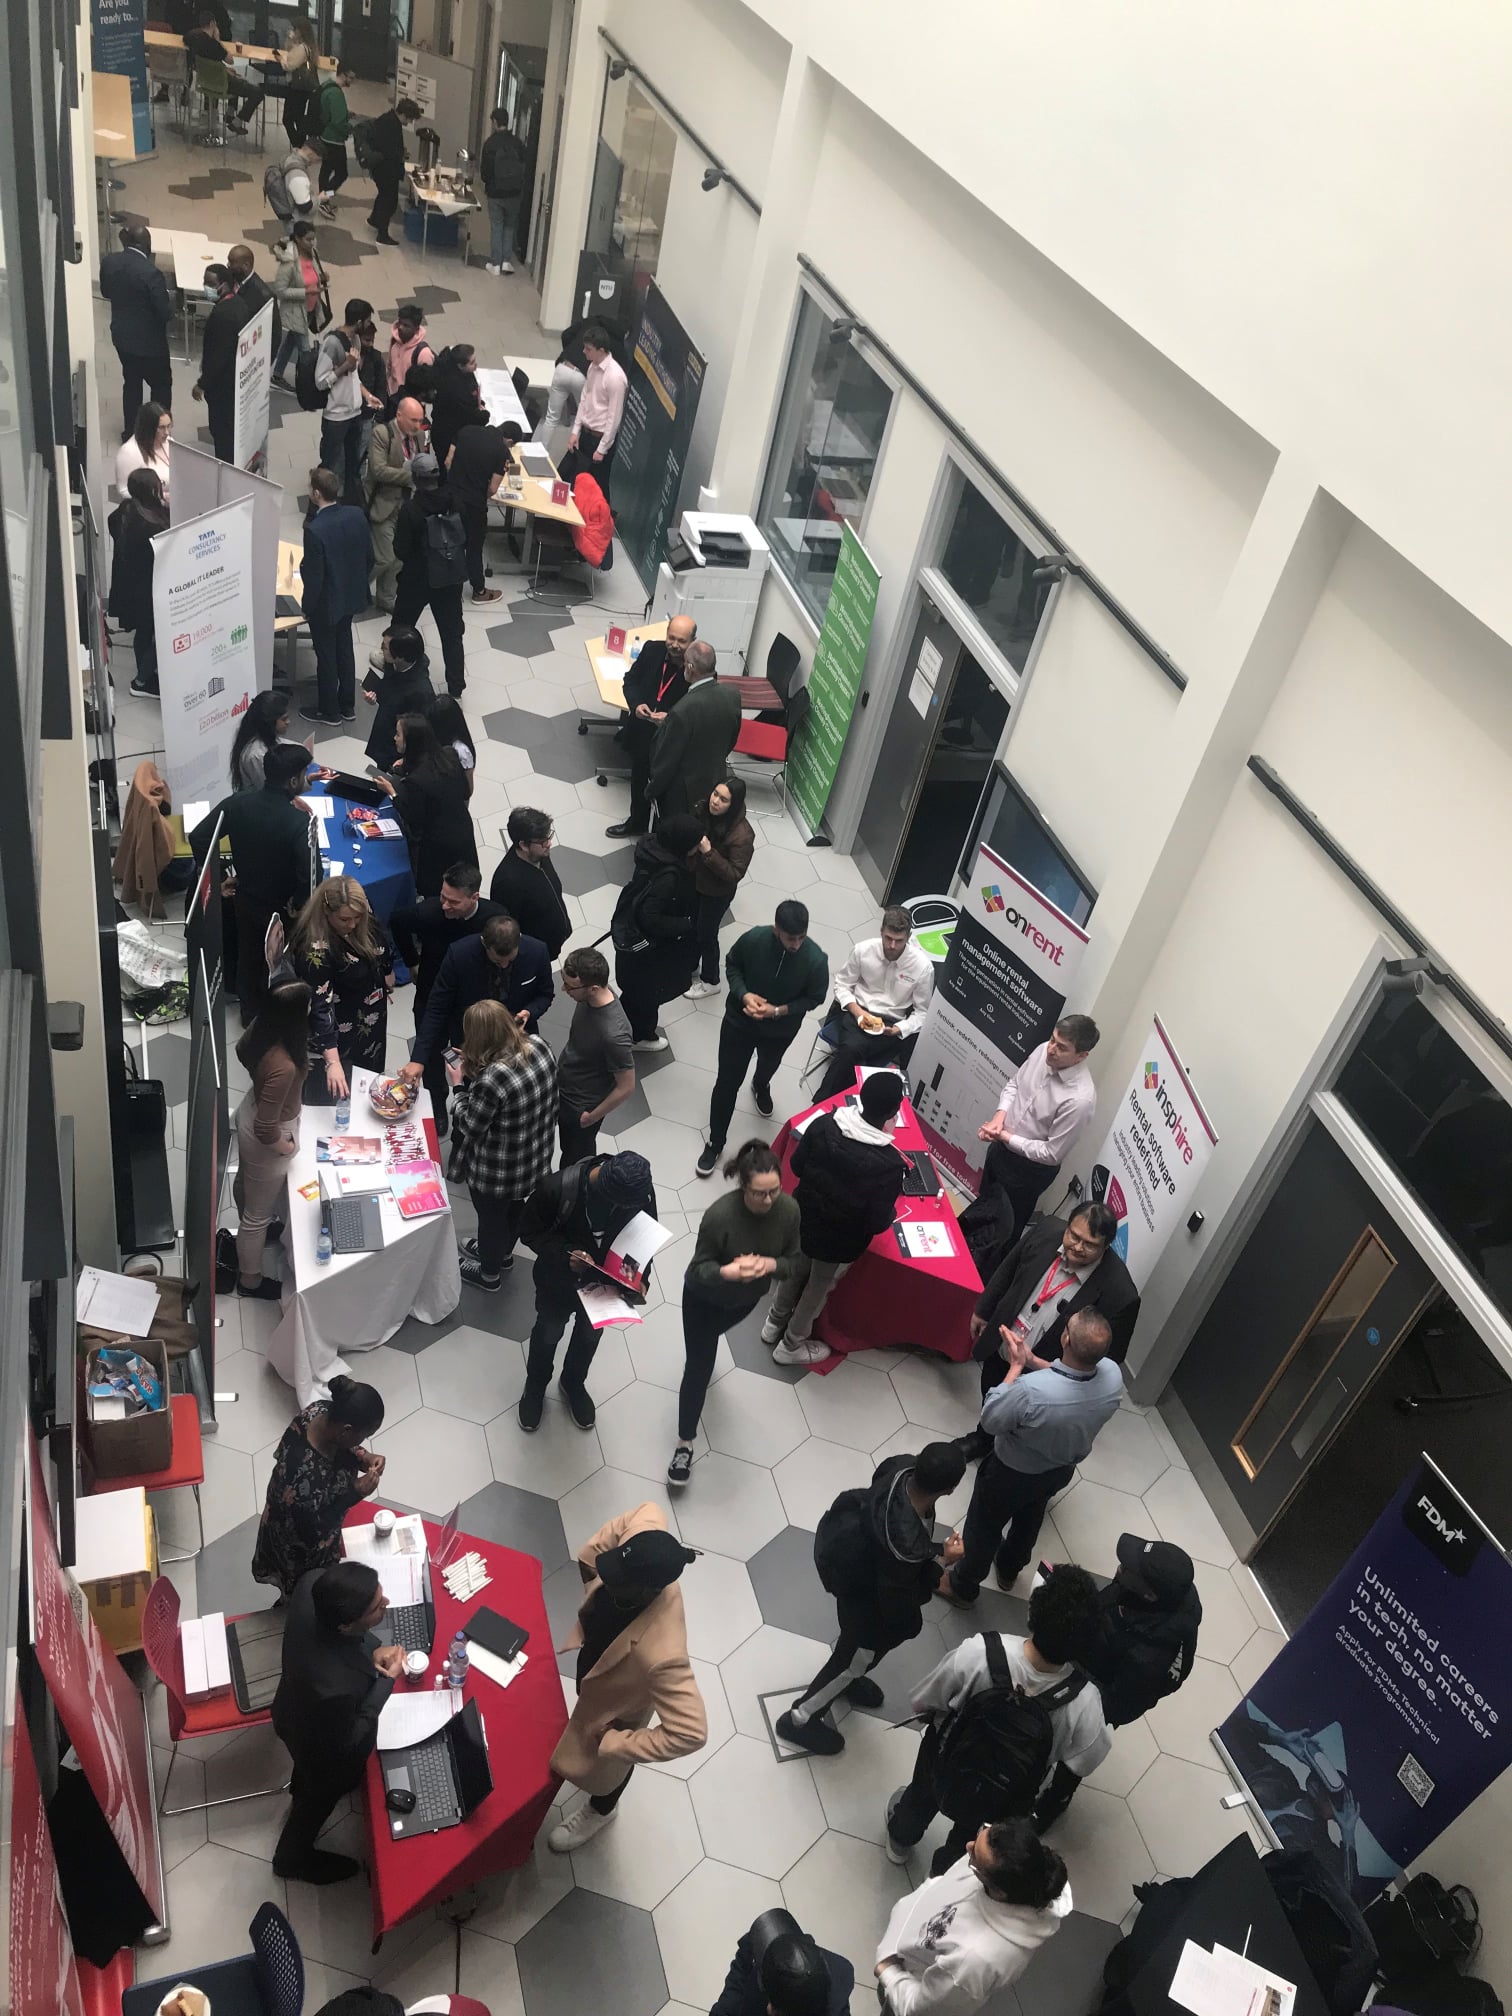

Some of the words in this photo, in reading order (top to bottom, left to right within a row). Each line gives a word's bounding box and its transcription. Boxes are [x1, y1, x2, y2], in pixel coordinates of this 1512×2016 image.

[100, 12, 121, 24] ready
[556, 488, 564, 499] 11
[188, 534, 226, 555] CONSULTANCY
[195, 543, 220, 560] SERVICES
[198, 530, 215, 542] TATA
[174, 578, 197, 592] GLOBAL
[197, 575, 202, 584] IT
[202, 566, 224, 580] LEADER
[184, 696, 198, 708] over
[983, 943, 1006, 968] Online
[1006, 964, 1030, 990] rental
[1006, 908, 1064, 966] onrent
[962, 938, 1010, 985] management
[1010, 981, 1043, 1016] software
[966, 957, 977, 970] next
[976, 966, 1000, 992] generation
[1004, 992, 1018, 1006] rental
[1018, 1004, 1038, 1026] software
[968, 967, 976, 978] the
[976, 975, 1000, 1000] equipment
[1000, 996, 1012, 1012] rental
[1012, 1006, 1030, 1028] industry
[956, 1028, 978, 1051] redefine,
[978, 1048, 1000, 1072] redesign
[1129, 1088, 1152, 1136] Rental
[1148, 1132, 1176, 1195] software
[1156, 1079, 1193, 1165] insphire
[934, 1147, 943, 1160] for
[942, 1156, 956, 1170] free
[956, 1170, 975, 1192] today
[1112, 1131, 1128, 1166] managing
[1126, 1161, 1134, 1180] your
[1132, 1178, 1142, 1202] entire
[1140, 1198, 1155, 1233] business
[1119, 1129, 1132, 1160] Industry
[1131, 1156, 1144, 1185] leading
[1141, 1182, 1155, 1216] solutions
[1130, 1124, 1160, 1191] redefined
[916, 1225, 932, 1253] onrent
[1417, 1495, 1456, 1542] FDM
[1349, 1599, 1384, 1638] your
[1385, 1640, 1437, 1706] degree.
[1356, 1582, 1370, 1604] in
[1374, 1601, 1410, 1650] tech,
[1414, 1648, 1434, 1673] no
[1436, 1674, 1492, 1739] matter
[1364, 1566, 1440, 1653] Unlimited
[1440, 1654, 1499, 1724] careers
[1336, 1632, 1374, 1678] Graduate
[1374, 1676, 1420, 1735] Programme
[1338, 1624, 1364, 1652] Apply
[1364, 1650, 1376, 1668] for
[1402, 1693, 1440, 1745] Technical
